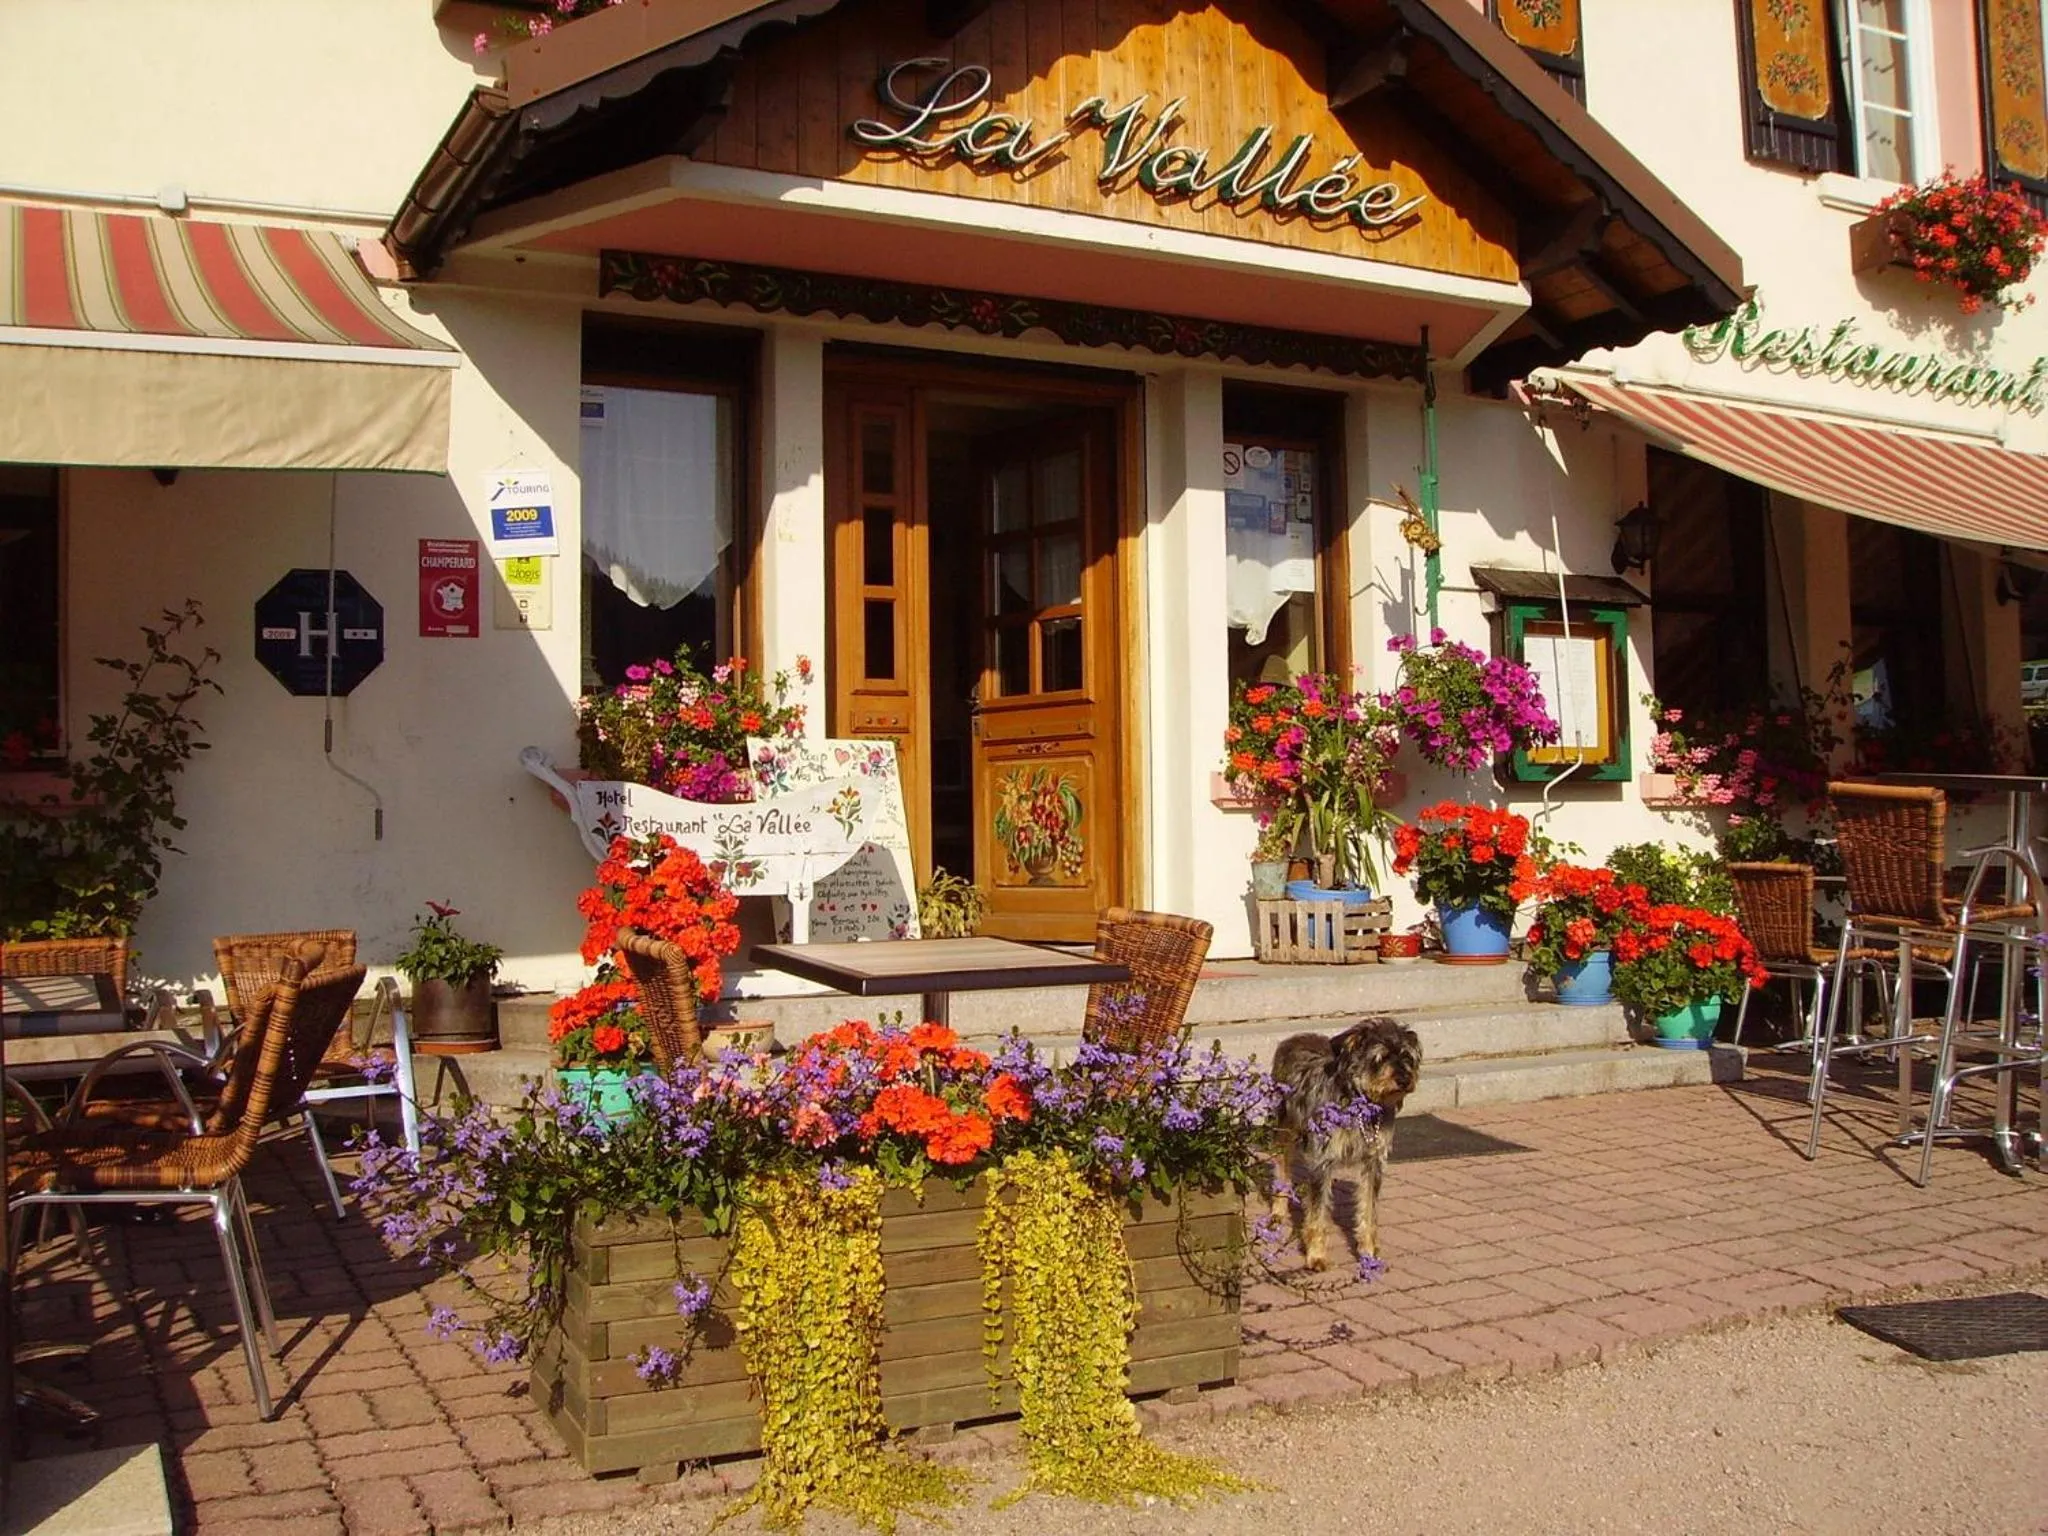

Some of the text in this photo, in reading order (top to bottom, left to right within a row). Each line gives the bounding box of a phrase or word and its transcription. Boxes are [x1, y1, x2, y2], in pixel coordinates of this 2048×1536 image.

[850, 57, 1428, 224] La Vallée
[1683, 286, 2048, 410] Restaurant
[506, 508, 538, 522] 2009
[421, 556, 476, 569] CHAMPERARD
[298, 611, 339, 657] H
[596, 788, 634, 809] Hotel
[622, 815, 708, 837] Restaurant
